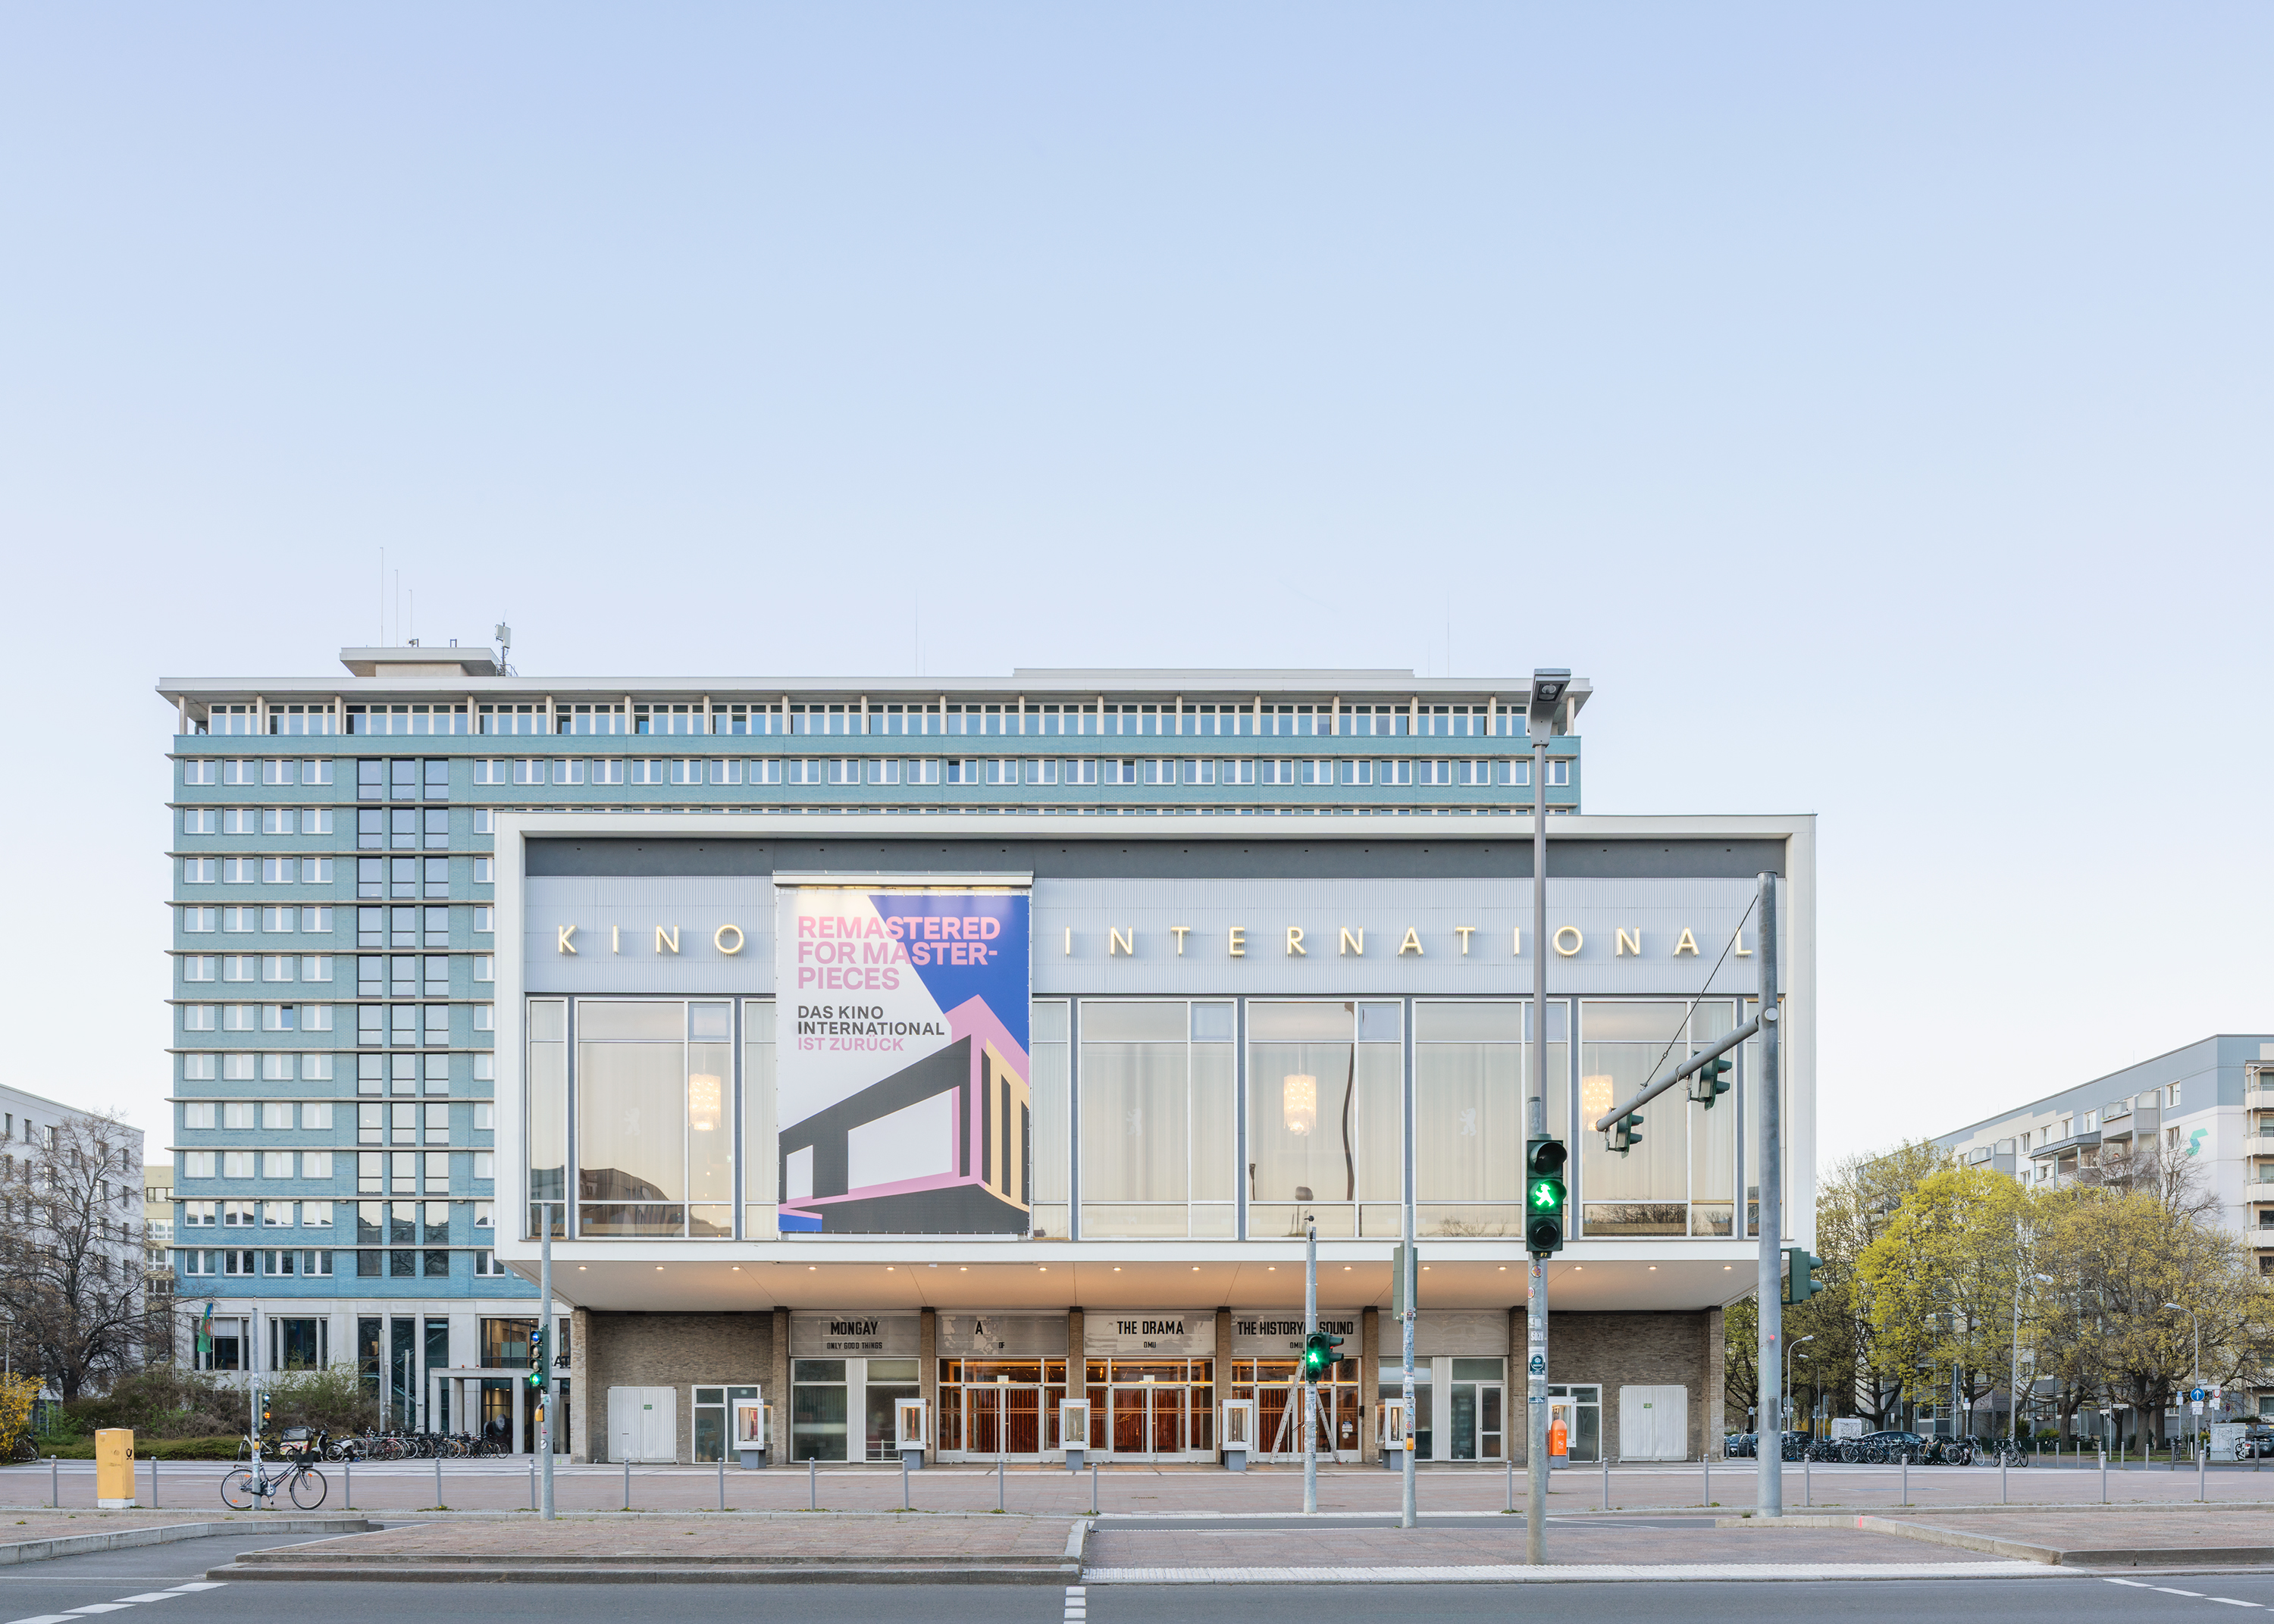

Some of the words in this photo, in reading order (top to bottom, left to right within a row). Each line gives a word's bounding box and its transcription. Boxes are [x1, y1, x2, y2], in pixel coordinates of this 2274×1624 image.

[798, 916, 1001, 940] REMASTERED
[558, 924, 745, 955] KINO
[1063, 925, 1753, 956] INTERNATIONAL
[798, 942, 856, 964] FOR
[863, 942, 998, 965] MASTER-
[798, 968, 900, 990] PIECES
[797, 1006, 835, 1020] DAS
[839, 1006, 883, 1020] KINO
[797, 1021, 944, 1036] INTERNATIONAL
[797, 1037, 825, 1051] IST
[829, 1035, 904, 1051] ZURÜCK
[831, 1322, 878, 1335] MONGAY
[976, 1321, 983, 1335] A
[1117, 1321, 1137, 1334] THE
[1142, 1321, 1184, 1334] DRAMA
[1238, 1322, 1256, 1335] THE
[1260, 1322, 1304, 1335] HISTORY
[1320, 1322, 1353, 1335] SOUND
